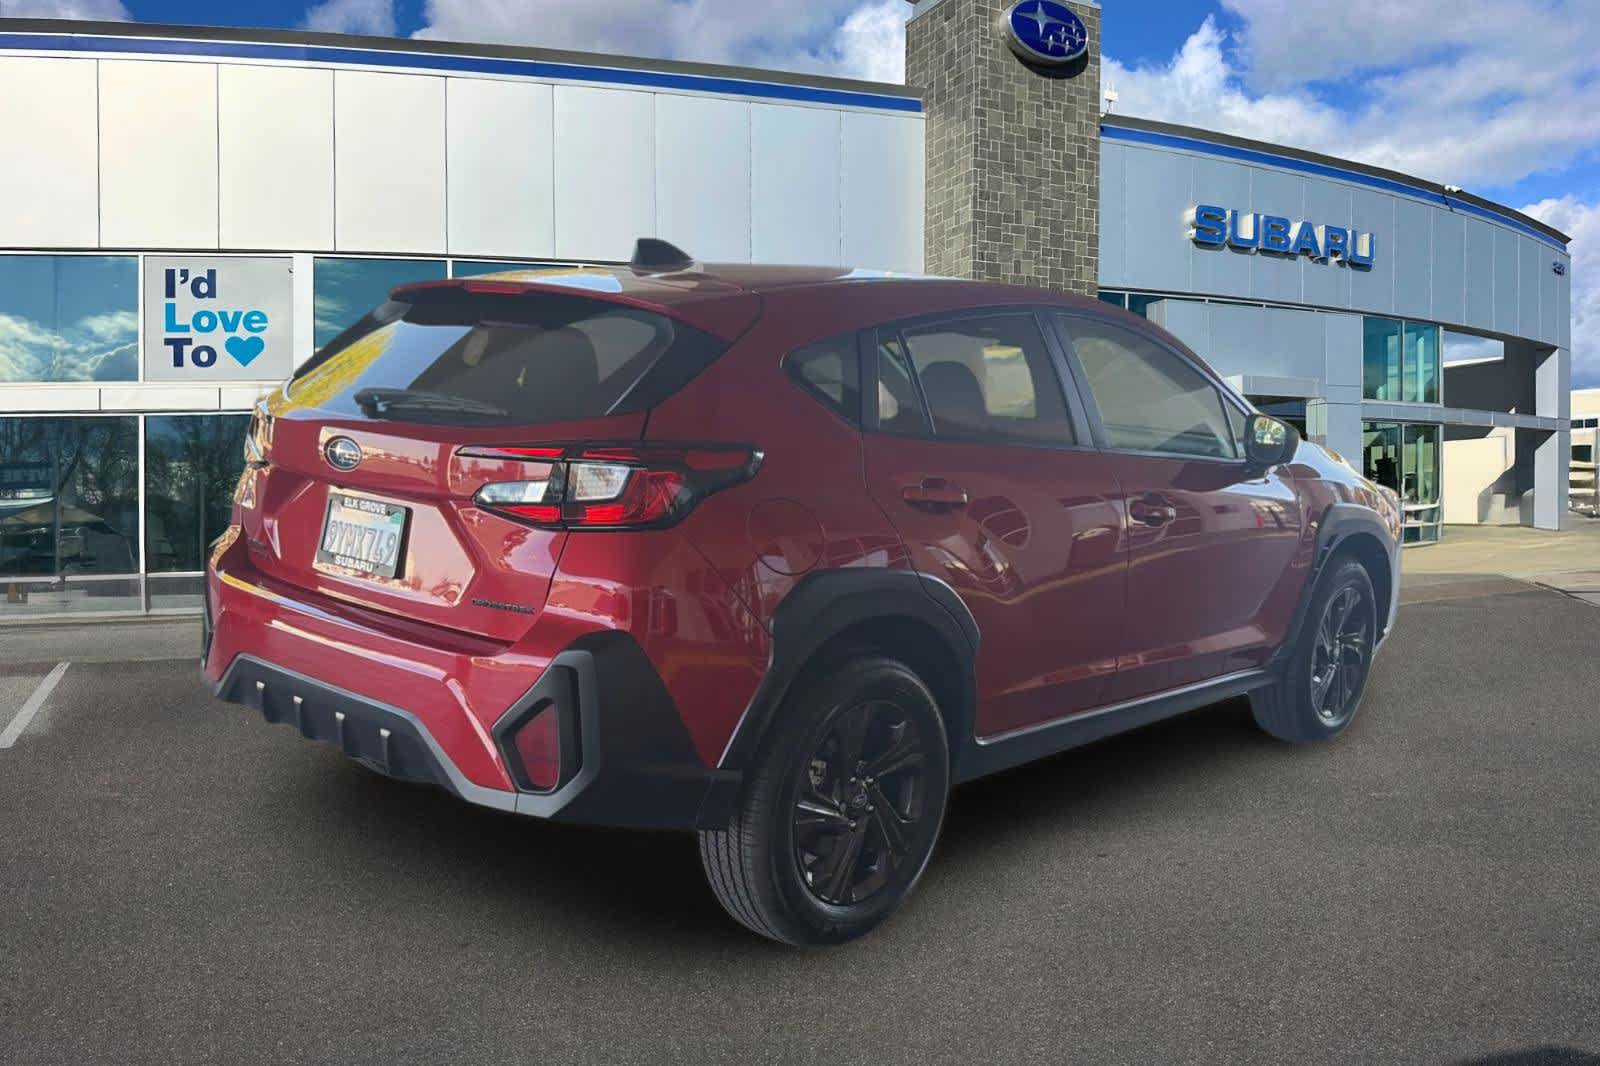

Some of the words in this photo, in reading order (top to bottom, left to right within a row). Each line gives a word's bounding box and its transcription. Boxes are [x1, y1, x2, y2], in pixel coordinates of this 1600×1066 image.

[1192, 204, 1376, 268] SUBARU
[164, 268, 217, 299] I'd
[164, 302, 269, 333] Love
[163, 337, 217, 368] To
[343, 496, 359, 510] ELK
[359, 501, 387, 515] GROVE
[335, 555, 374, 573] SUBARU
